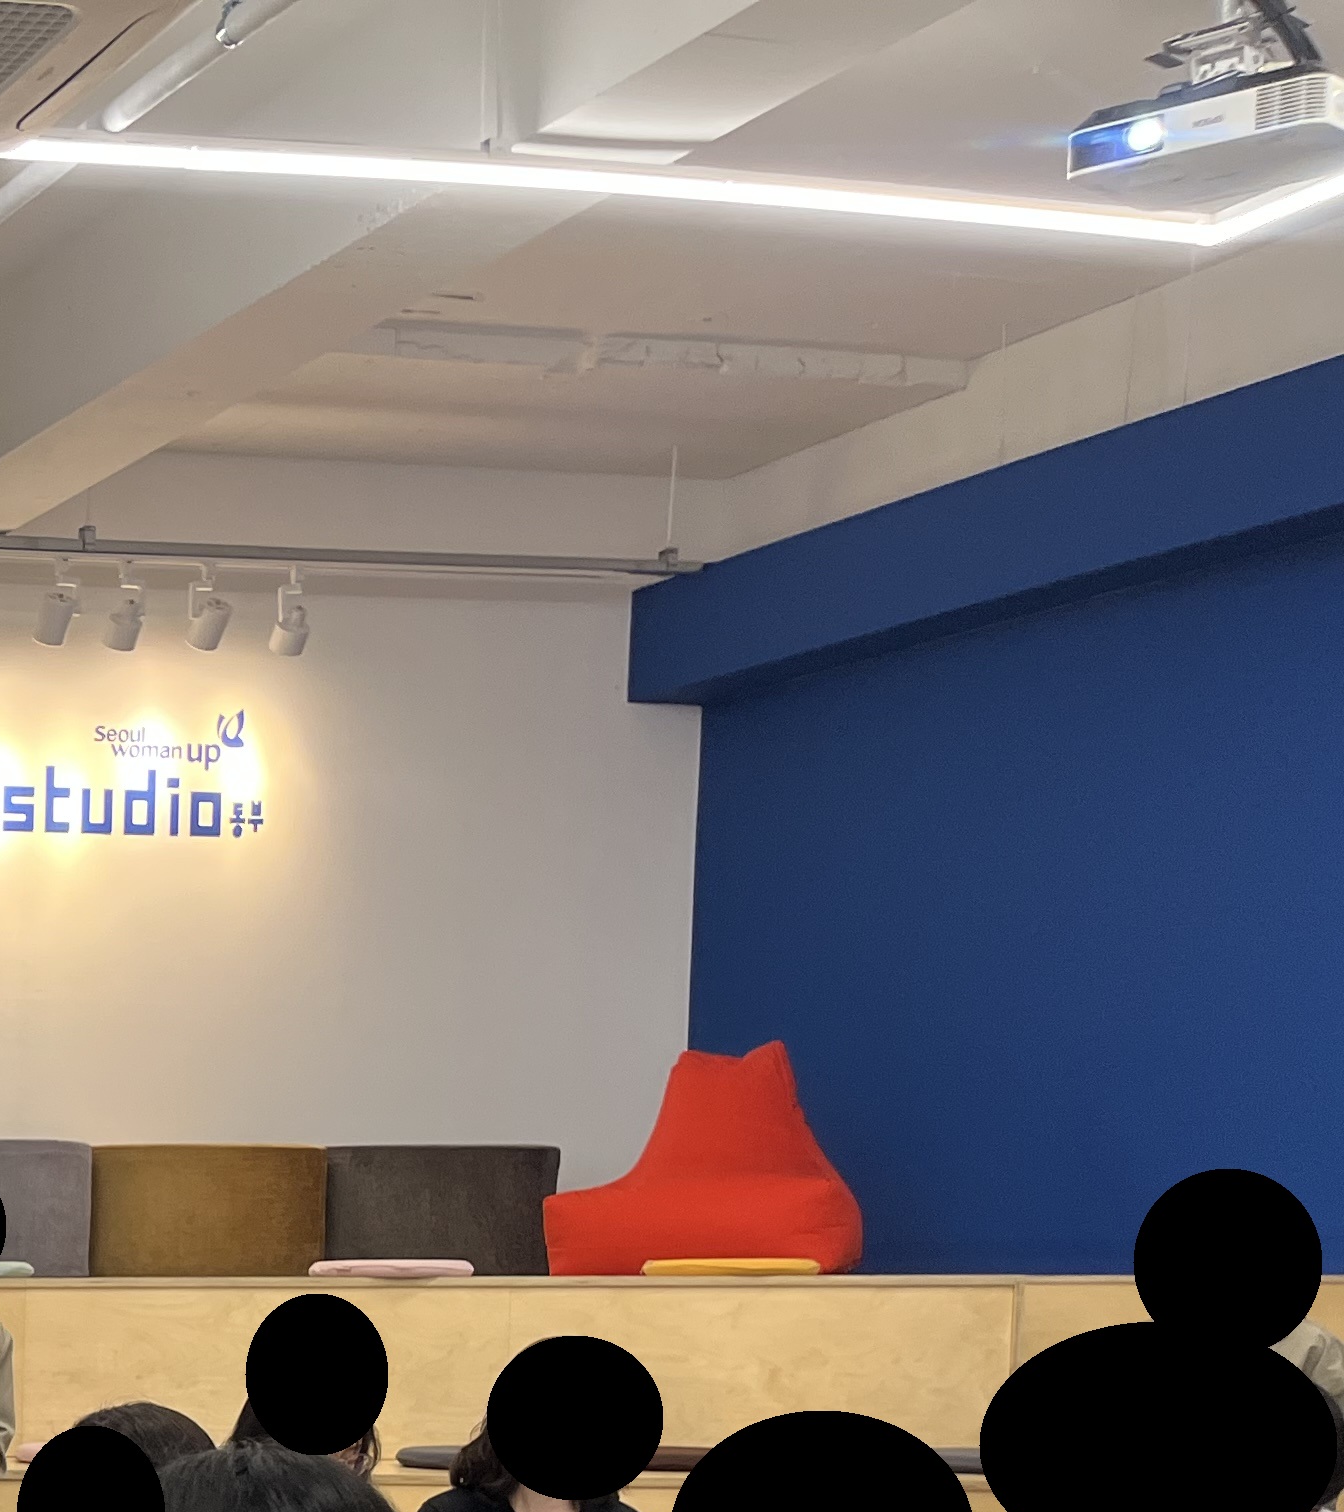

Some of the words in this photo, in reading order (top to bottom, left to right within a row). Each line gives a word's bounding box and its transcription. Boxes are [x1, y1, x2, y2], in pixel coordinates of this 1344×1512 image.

[94, 725, 145, 744] Seoul
[111, 744, 183, 759] woman
[186, 743, 222, 771] up
[2, 765, 221, 837] studio
[229, 801, 264, 838] 동부
